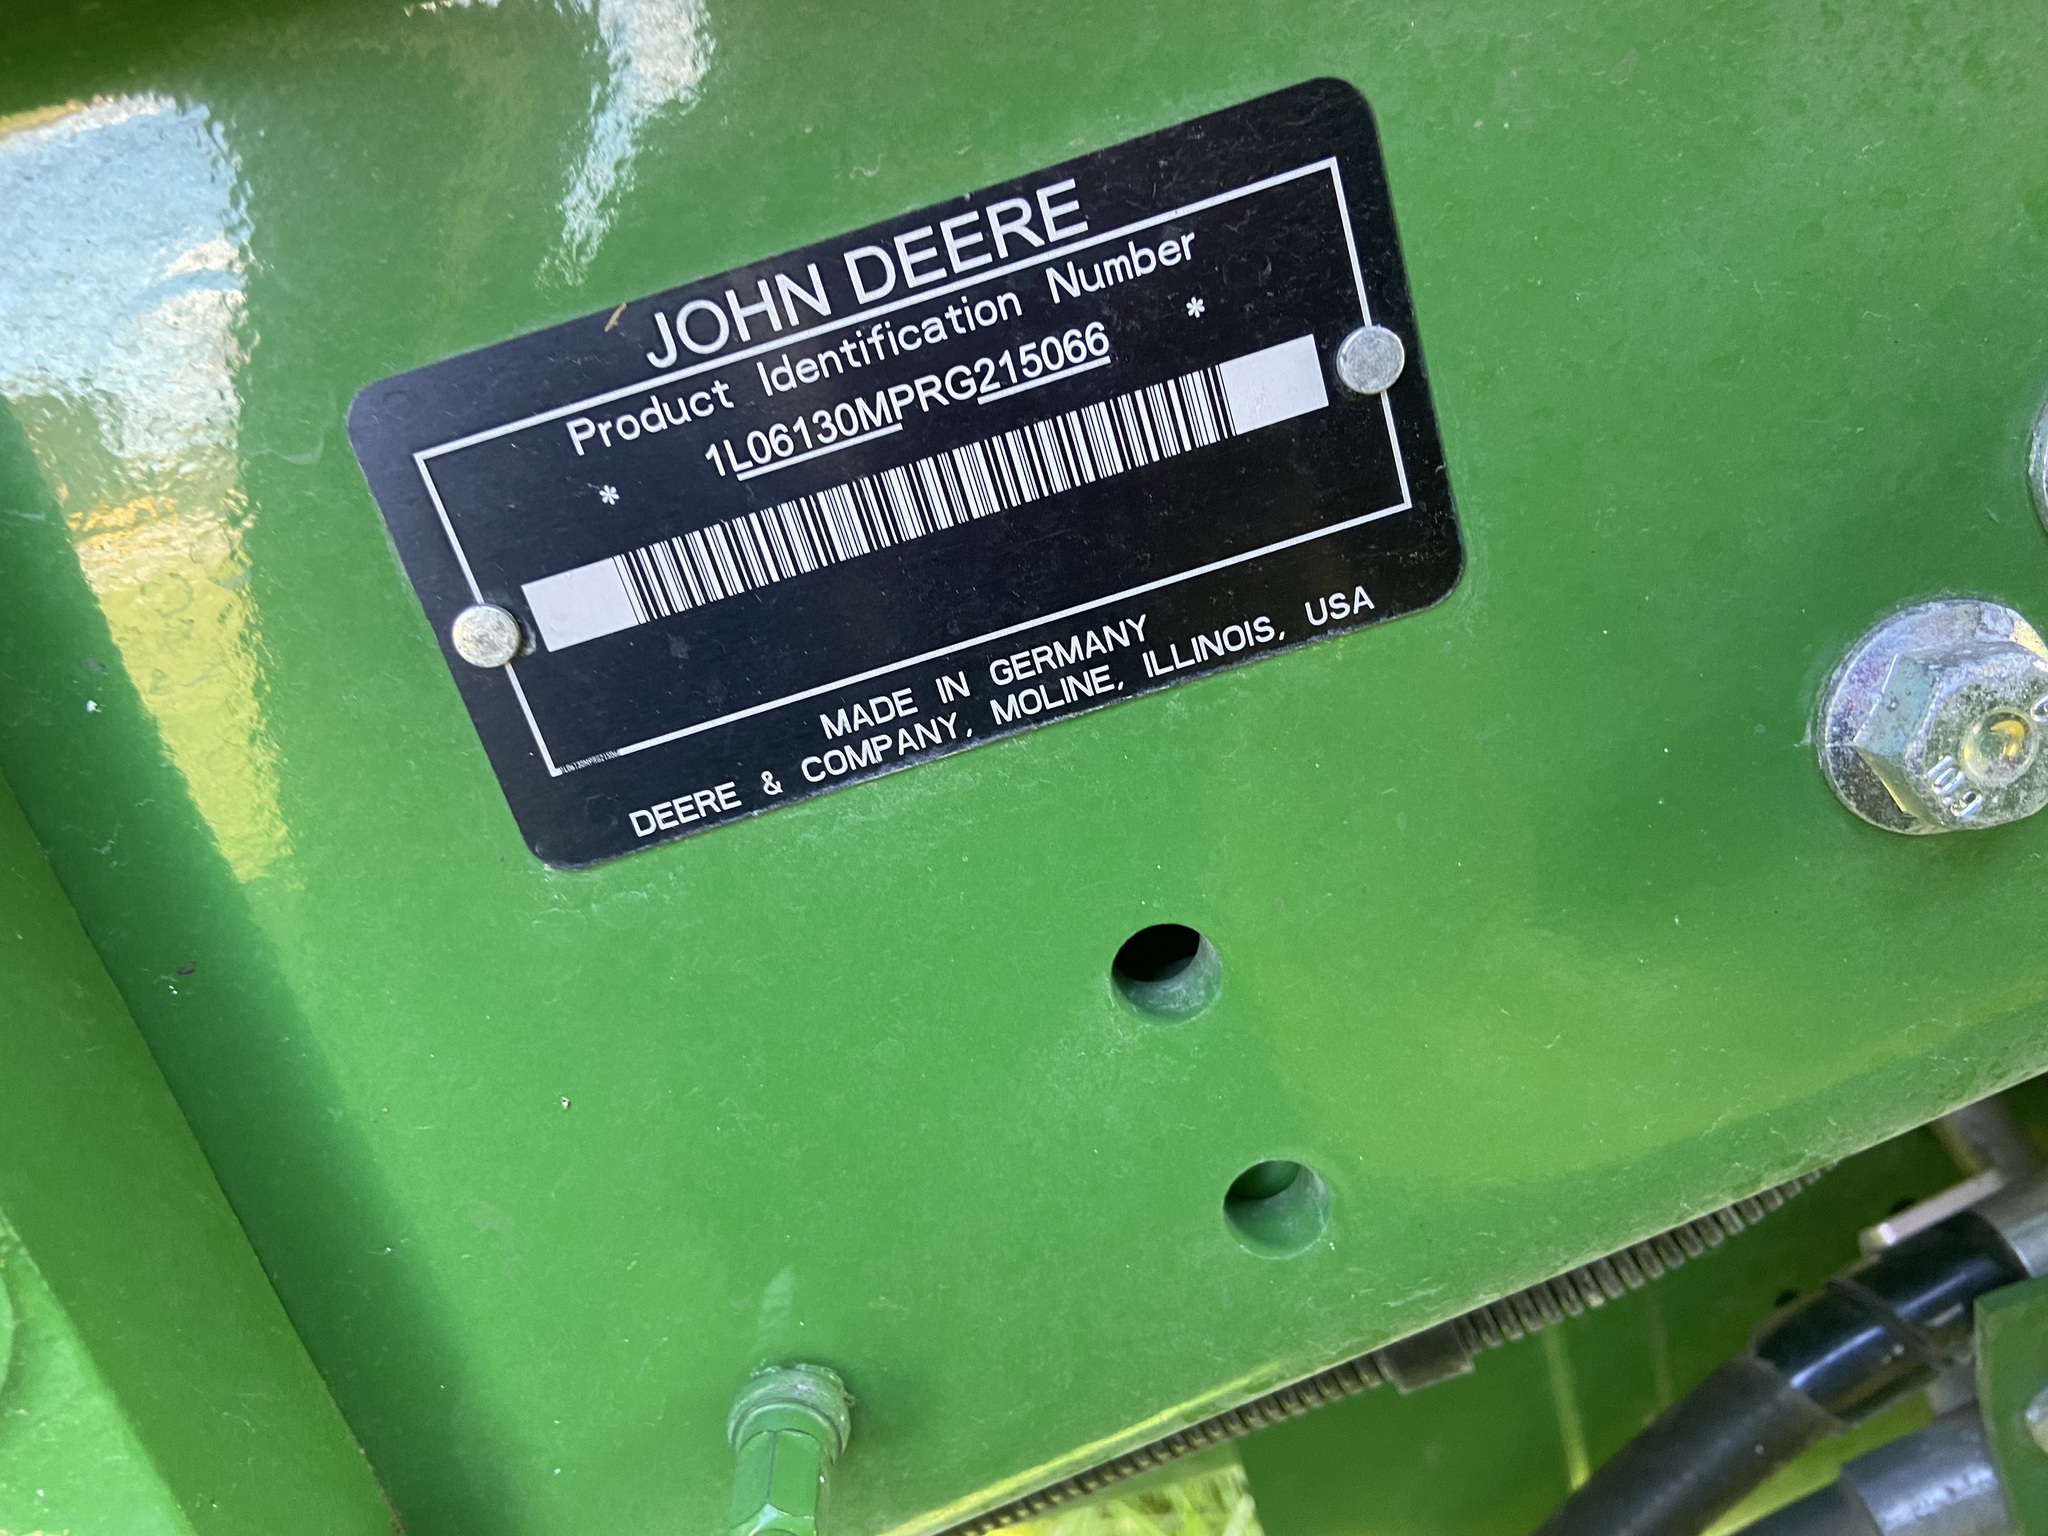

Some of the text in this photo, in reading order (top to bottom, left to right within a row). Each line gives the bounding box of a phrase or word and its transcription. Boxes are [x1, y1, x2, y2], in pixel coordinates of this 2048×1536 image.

[565, 231, 1195, 457] Product Identification Number
[647, 178, 1089, 369] JOHN DEERE
[705, 321, 1110, 477] 1L06130MPRG215066
[628, 585, 1375, 838] DEERE & COMPANY, MOLINE, ILLINOIS, USA
[819, 613, 1147, 740] MADE IN GERMANY
